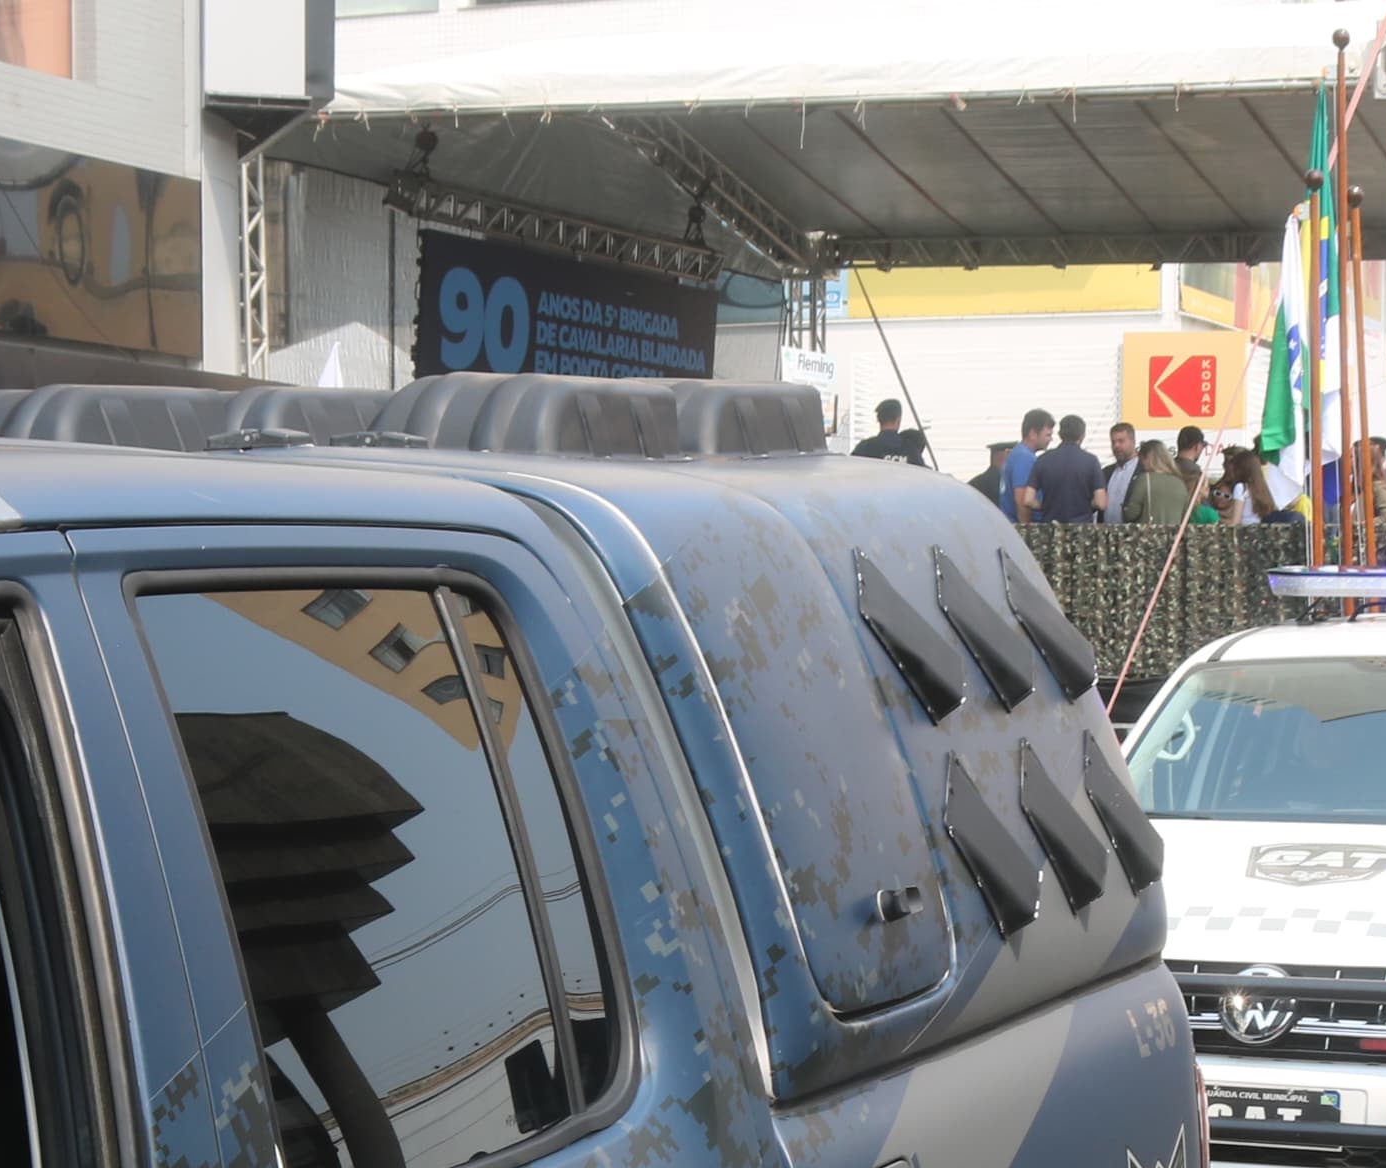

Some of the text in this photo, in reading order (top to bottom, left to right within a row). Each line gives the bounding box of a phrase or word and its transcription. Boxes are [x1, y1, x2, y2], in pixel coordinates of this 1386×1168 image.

[439, 267, 530, 374] 90
[538, 292, 581, 321] ANOS
[582, 301, 603, 326] DA
[619, 306, 679, 341] BRIGADA
[534, 350, 558, 374] EM
[560, 353, 609, 377] PONTA
[536, 321, 706, 372] DE CAVALARIA BLINDADA
[797, 353, 835, 379] Fleming
[1201, 359, 1212, 415] KODAK
[1126, 997, 1177, 1059] L-36
[1239, 1091, 1262, 1101] CIVIL
[1262, 1093, 1310, 1104] MUNICIPAL
